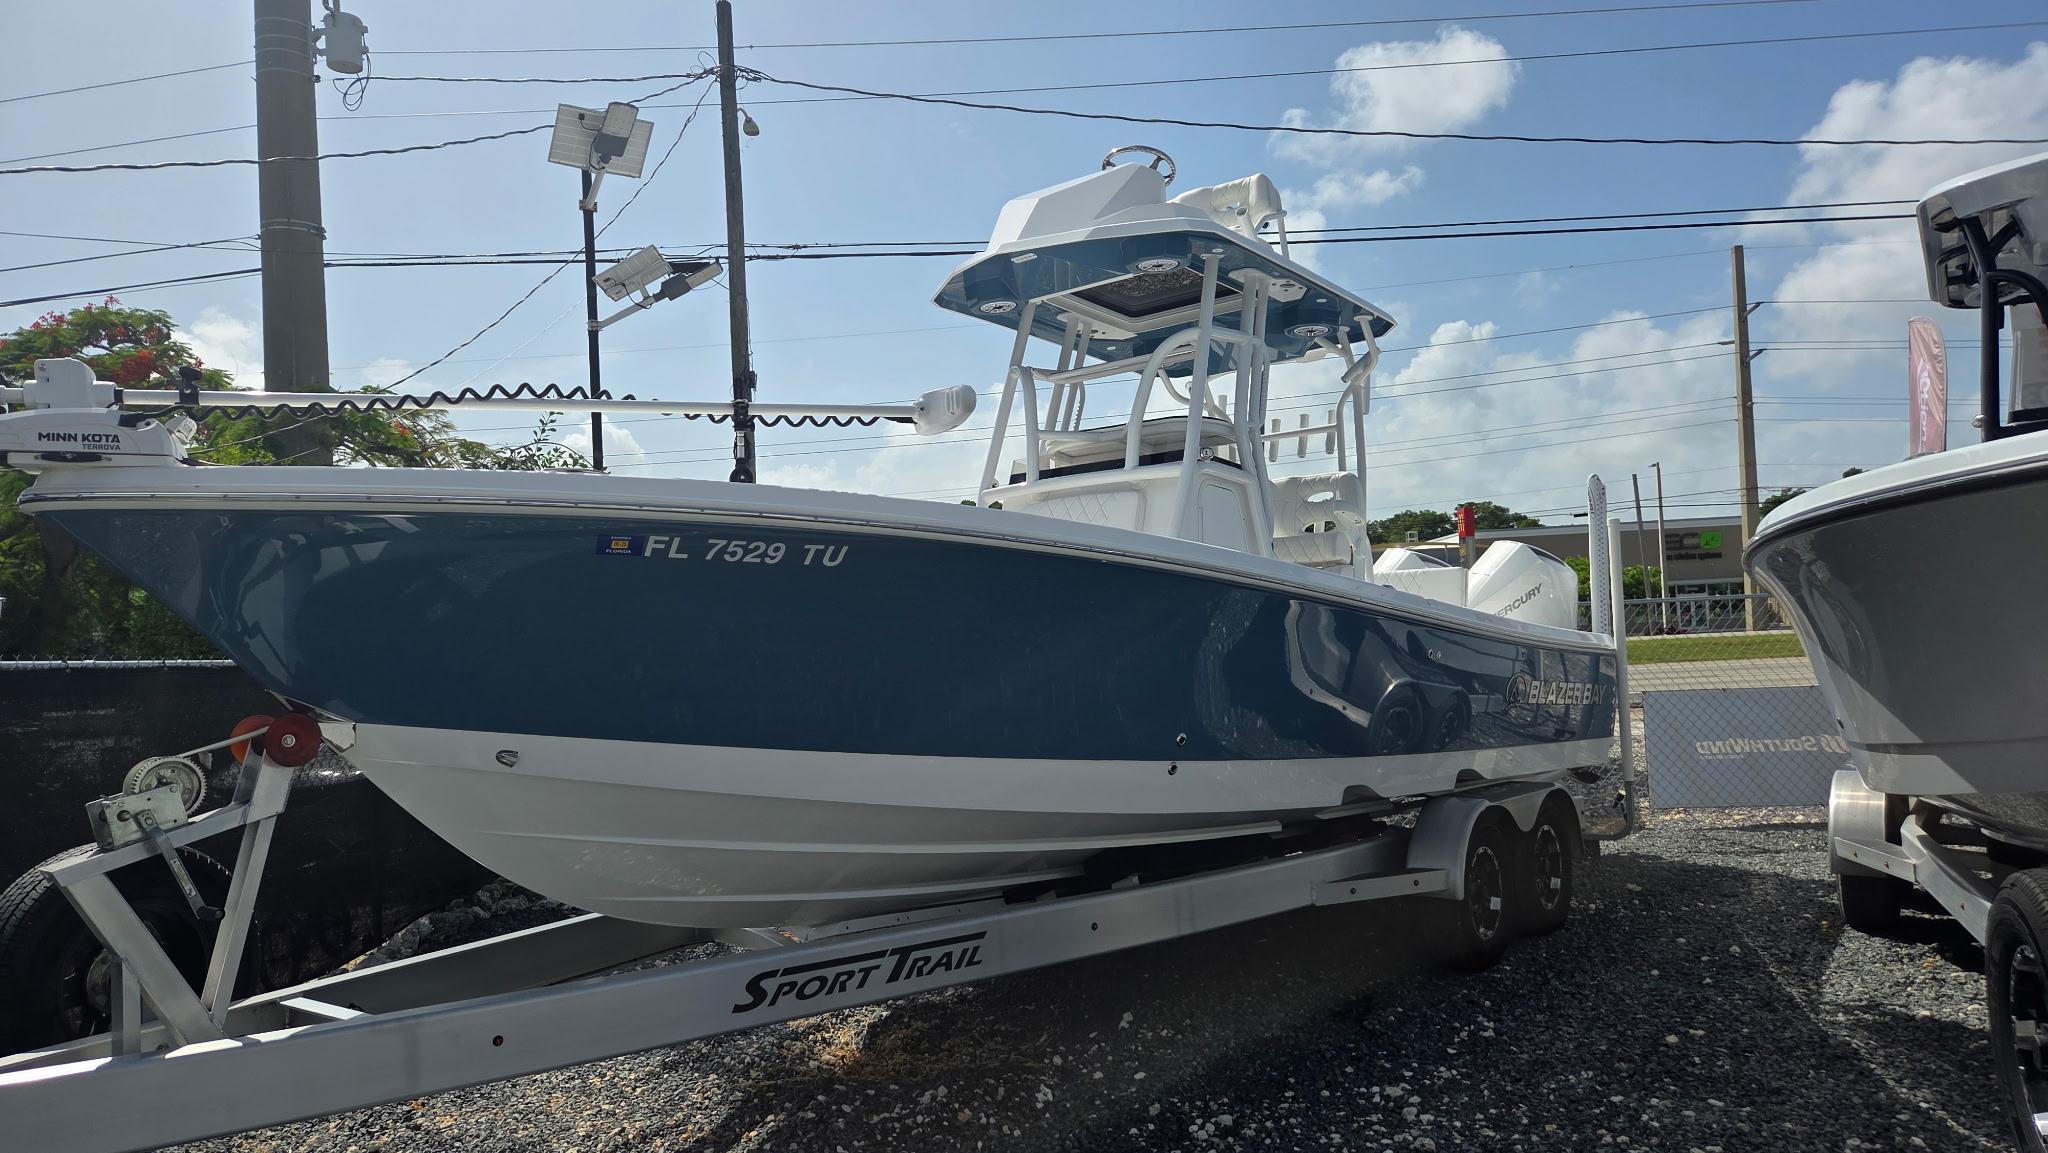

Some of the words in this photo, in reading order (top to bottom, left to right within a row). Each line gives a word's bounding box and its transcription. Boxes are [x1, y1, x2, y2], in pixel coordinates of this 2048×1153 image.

[38, 432, 78, 442] MINN
[81, 433, 121, 443] KOTA
[82, 443, 121, 451] TERROVA
[644, 536, 689, 559] FL
[705, 538, 786, 564] 7529
[803, 544, 848, 567] TU
[1494, 582, 1543, 617] ERCURY
[1528, 680, 1583, 705] BLAZER
[1582, 682, 1607, 705] BAY
[731, 948, 889, 1014] SPORT
[886, 931, 987, 984] TRAIL
